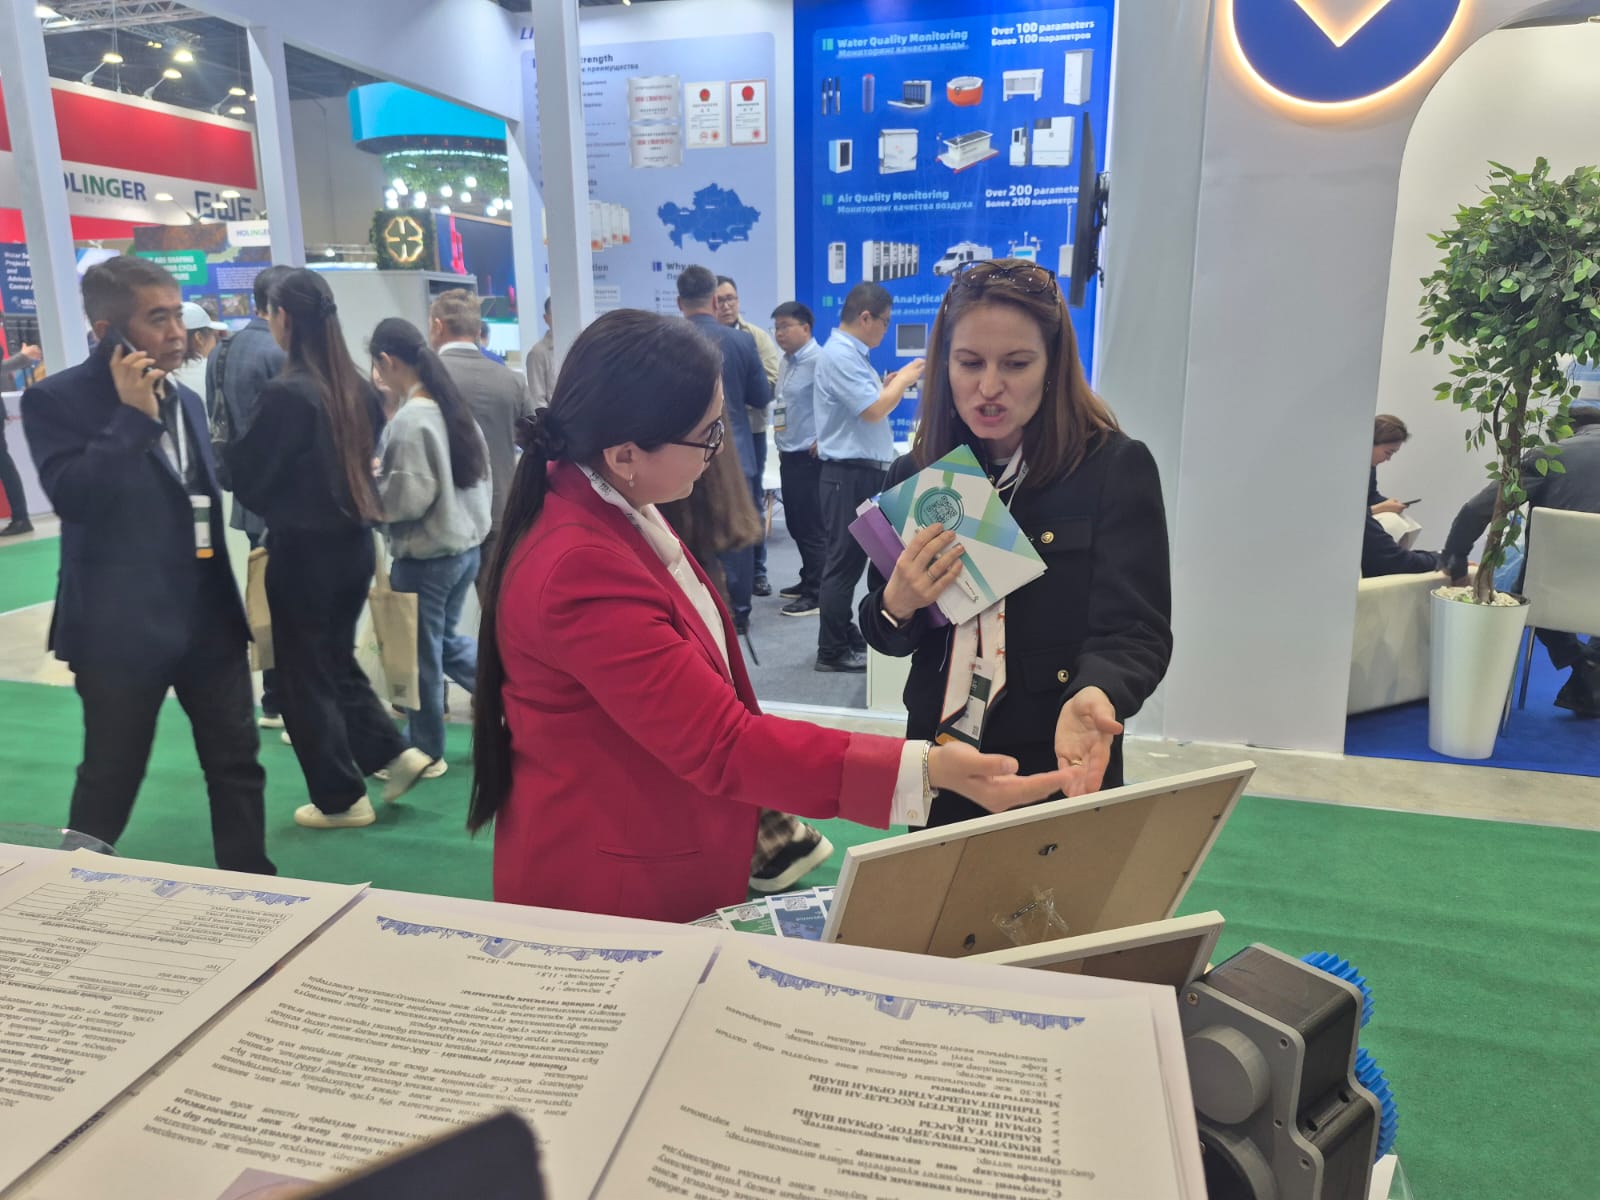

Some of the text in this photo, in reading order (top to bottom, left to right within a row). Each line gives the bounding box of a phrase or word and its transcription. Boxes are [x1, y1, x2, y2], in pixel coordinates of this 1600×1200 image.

[992, 20, 1095, 36] Over 100 parameters
[838, 29, 968, 48] Water Quality Monitoring
[992, 32, 1091, 46] Более 100 параметров
[64, 173, 147, 201] LINGER
[986, 184, 1079, 198] Over 200 paramete
[838, 189, 949, 203] Air Quality Monitoring
[1012, 196, 1031, 207] 200
[1032, 197, 1078, 207] параметро
[838, 204, 891, 215] Мониторинг
[666, 262, 687, 271] Why
[809, 1074, 1040, 1114] ТЫНЫШТАНДЫРАТЫН ОРМАН ШАЙЫ
[812, 1084, 842, 1095] ШӘЙ
[164, 1106, 181, 1115] сүт
[183, 1111, 201, 1122] бар
[793, 1108, 834, 1122] ШАЙЫ
[919, 1102, 991, 1117] ЖИДЕКТЕРІ
[837, 1117, 883, 1130] ОРМАН
[957, 1116, 1042, 1133] ОРМАН ШӘЙ
[995, 1112, 1042, 1124] ОРМАН
[936, 1163, 957, 1171] мен
[973, 1167, 1061, 1187] Полифенолдар
